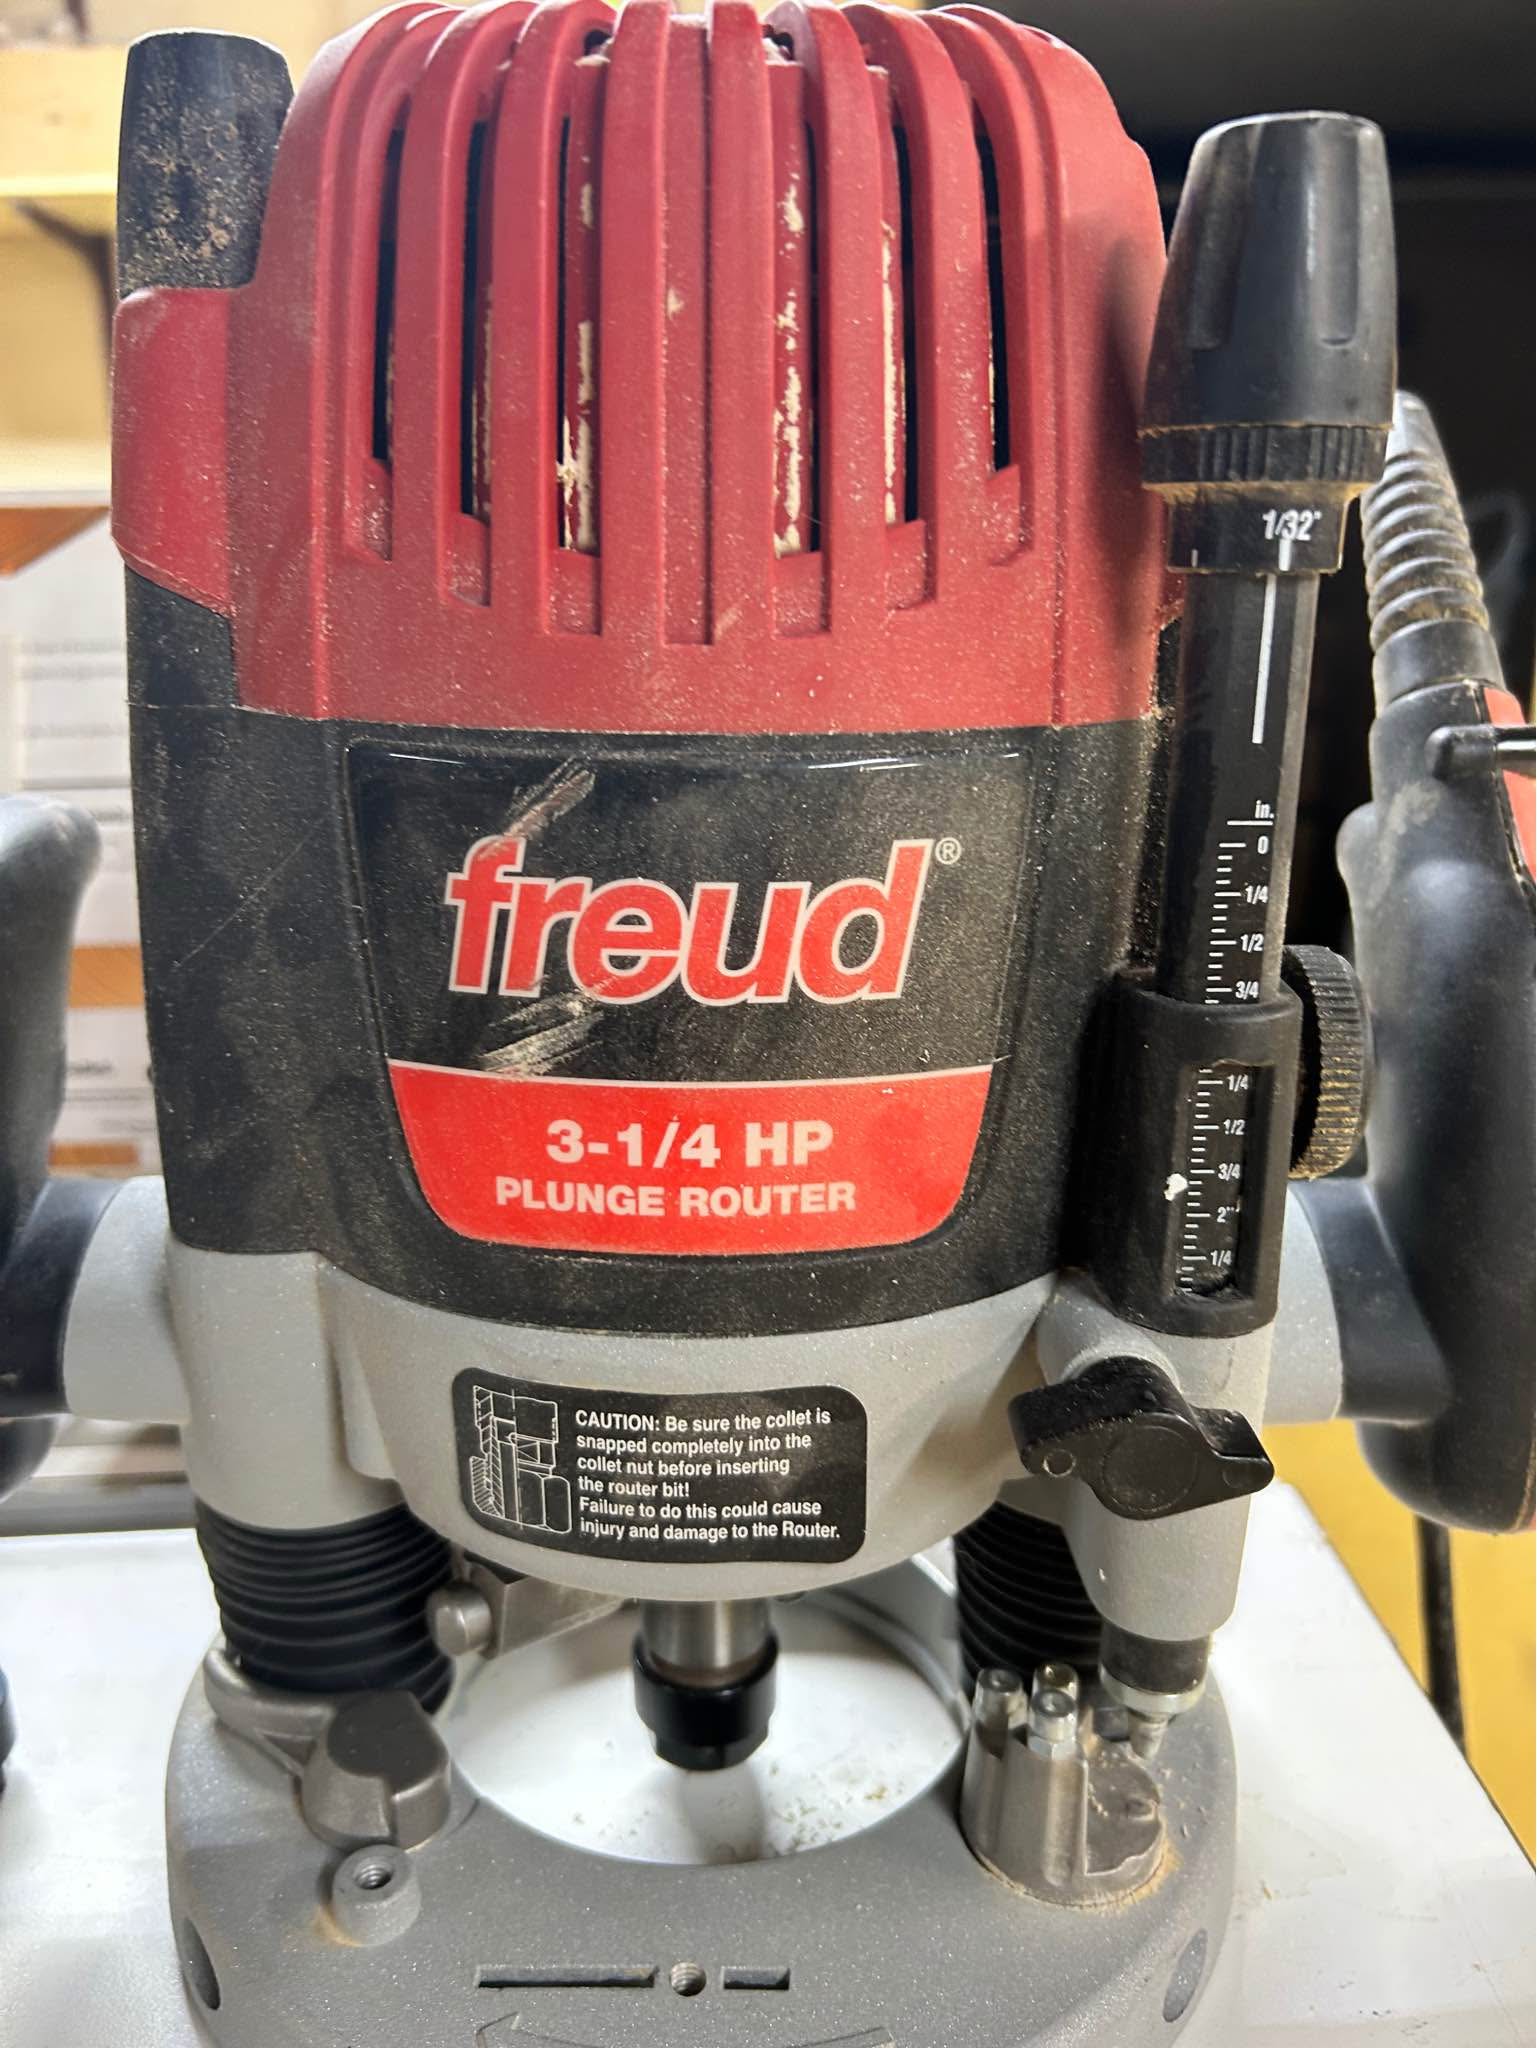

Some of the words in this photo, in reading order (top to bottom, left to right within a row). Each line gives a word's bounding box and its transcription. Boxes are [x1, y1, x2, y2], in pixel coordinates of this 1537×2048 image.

[1254, 800, 1275, 819] in.
[1257, 835, 1269, 854] 0
[1245, 885, 1269, 904] 1/4
[445, 835, 934, 1006] freud
[1240, 934, 1264, 951] 1/2
[1235, 981, 1259, 999] 3/4
[1228, 1074, 1249, 1091] 1/4
[1223, 1119, 1245, 1136] 1/2
[546, 1119, 721, 1169] 3-1/4
[745, 1120, 834, 1167] HP
[1217, 1163, 1240, 1181] 3/4
[496, 1176, 665, 1217] PLUNGE
[680, 1182, 856, 1217] ROUTER
[1210, 1250, 1232, 1267] 1/4
[575, 1409, 660, 1432] CAUTION:
[665, 1415, 688, 1432] Be
[692, 1418, 730, 1432] sure
[734, 1413, 761, 1430] the
[765, 1409, 811, 1429] collet
[816, 1407, 831, 1424] is
[576, 1434, 647, 1455] snapped
[651, 1436, 743, 1458] completely
[748, 1435, 780, 1452] into
[785, 1432, 812, 1449] the
[577, 1455, 622, 1473] collet
[626, 1460, 654, 1475] nut
[658, 1460, 712, 1476] before
[716, 1456, 790, 1476] inserting
[578, 1475, 604, 1492] the
[608, 1481, 658, 1497] router
[662, 1481, 690, 1497] bit!
[579, 1496, 635, 1516] Failure
[639, 1503, 656, 1518] to
[660, 1503, 682, 1519] do
[686, 1503, 717, 1519] this
[721, 1500, 768, 1518] could
[772, 1501, 822, 1515] cause
[580, 1516, 625, 1540] injury
[629, 1524, 660, 1540] and
[663, 1524, 728, 1543] damage
[731, 1523, 749, 1538] to
[752, 1521, 778, 1537] the
[782, 1520, 841, 1539] Router.
